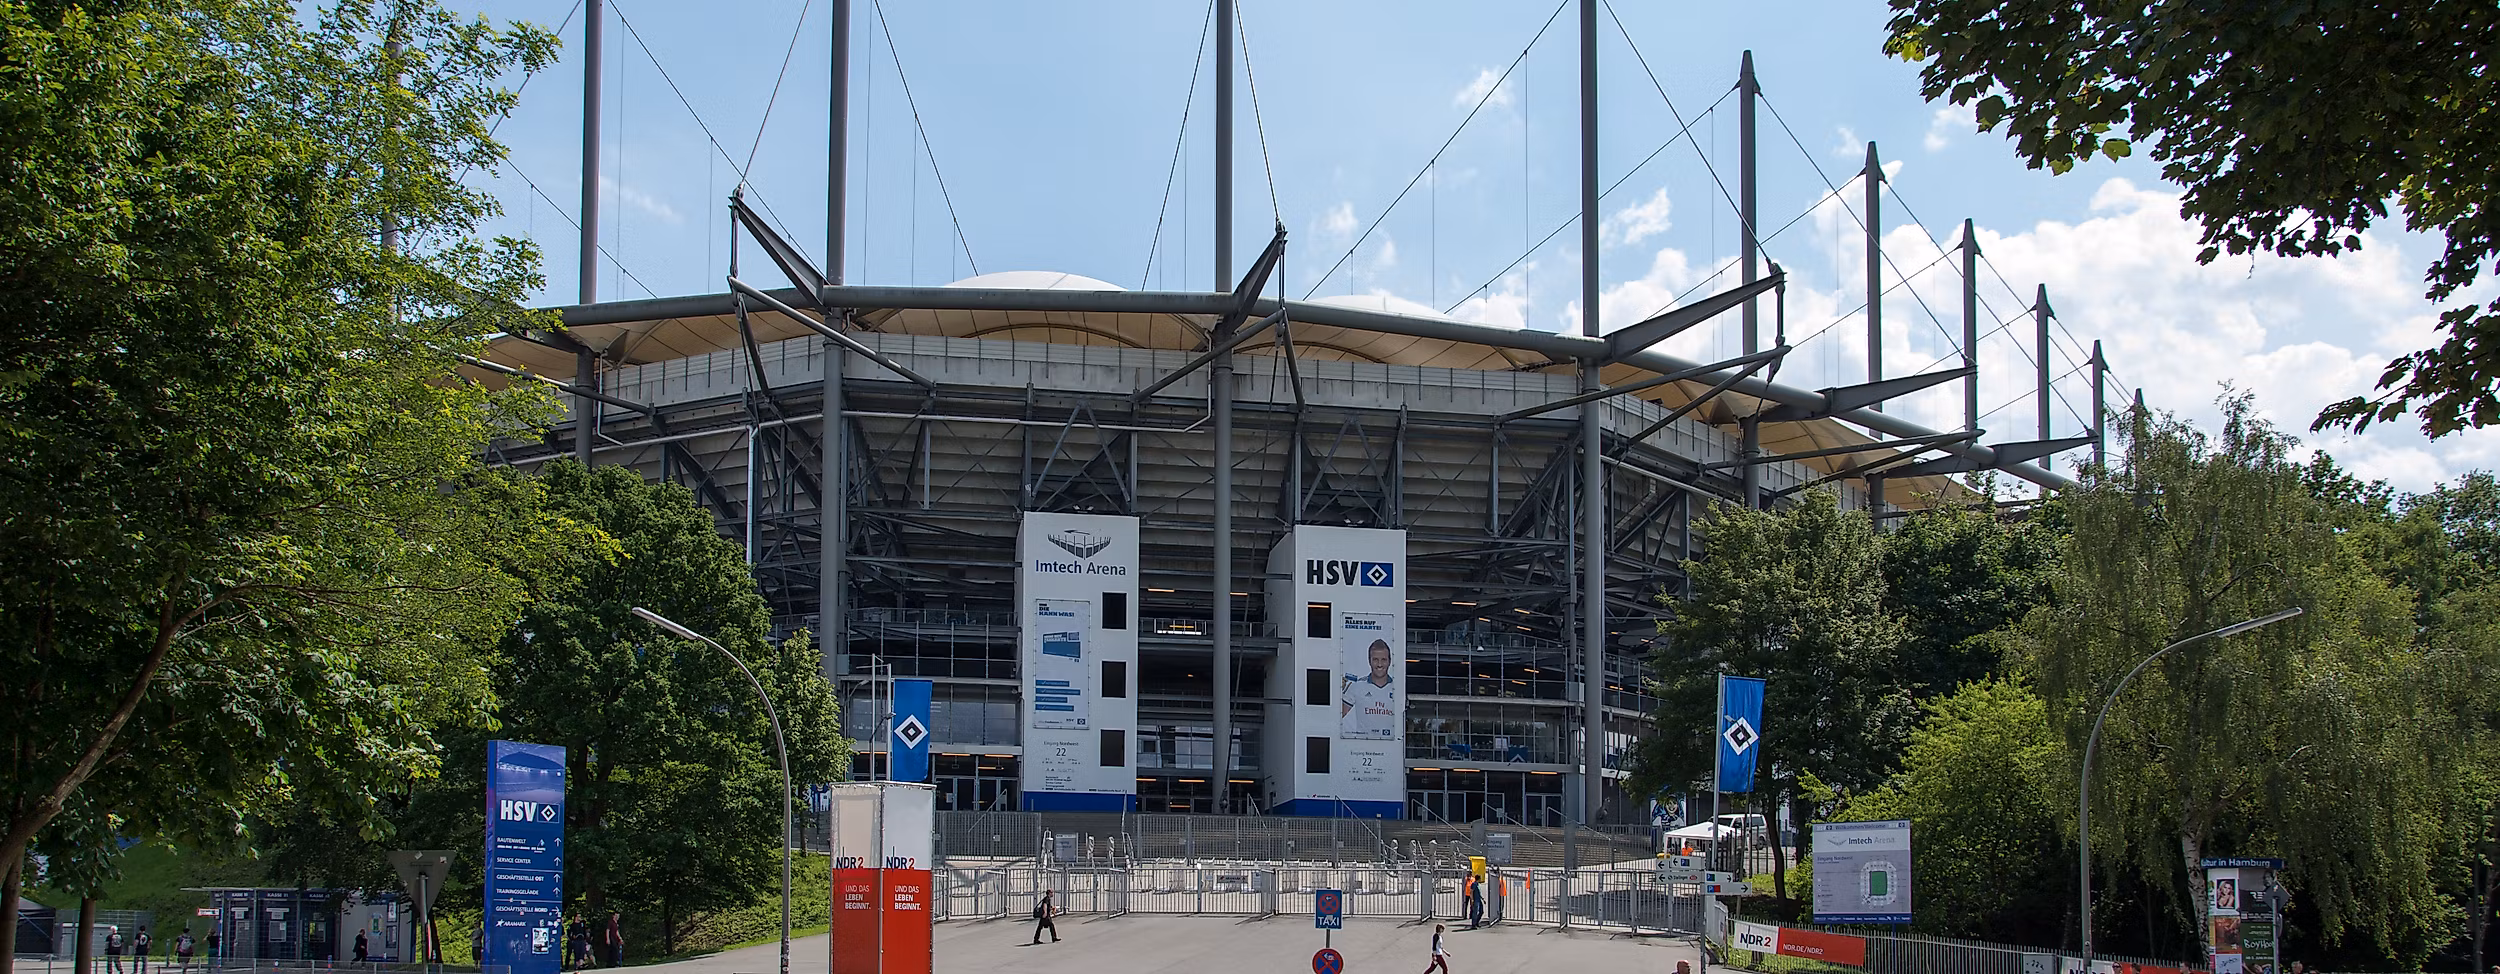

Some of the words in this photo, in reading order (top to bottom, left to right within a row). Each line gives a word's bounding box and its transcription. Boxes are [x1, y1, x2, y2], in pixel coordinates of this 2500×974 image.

[1035, 559, 1082, 574] Imtech
[1086, 562, 1126, 576] Arena
[1306, 559, 1360, 586] HSV
[1375, 701, 1385, 710] Fly
[1364, 706, 1394, 716] Emirates
[1056, 747, 1067, 757] 22
[1362, 757, 1373, 767] 22
[500, 798, 537, 822] HSV
[1848, 836, 1873, 845] Imtech
[1874, 836, 1896, 844] Arena
[2218, 858, 2227, 867] in
[2228, 858, 2271, 868] Hamburg
[496, 888, 539, 896] TRAININGSGELÄNDE
[845, 884, 857, 893] UND
[858, 885, 870, 893] DAS
[894, 884, 907, 893] UND
[908, 885, 920, 893] DAS
[845, 893, 863, 901] LEBEN
[894, 893, 914, 902] LEBEN
[844, 902, 871, 910] BEGINNT.
[894, 902, 922, 911] BEGINNT.
[1317, 915, 1340, 926] TAXI
[1782, 943, 1824, 955] NDR.DE/NDR2
